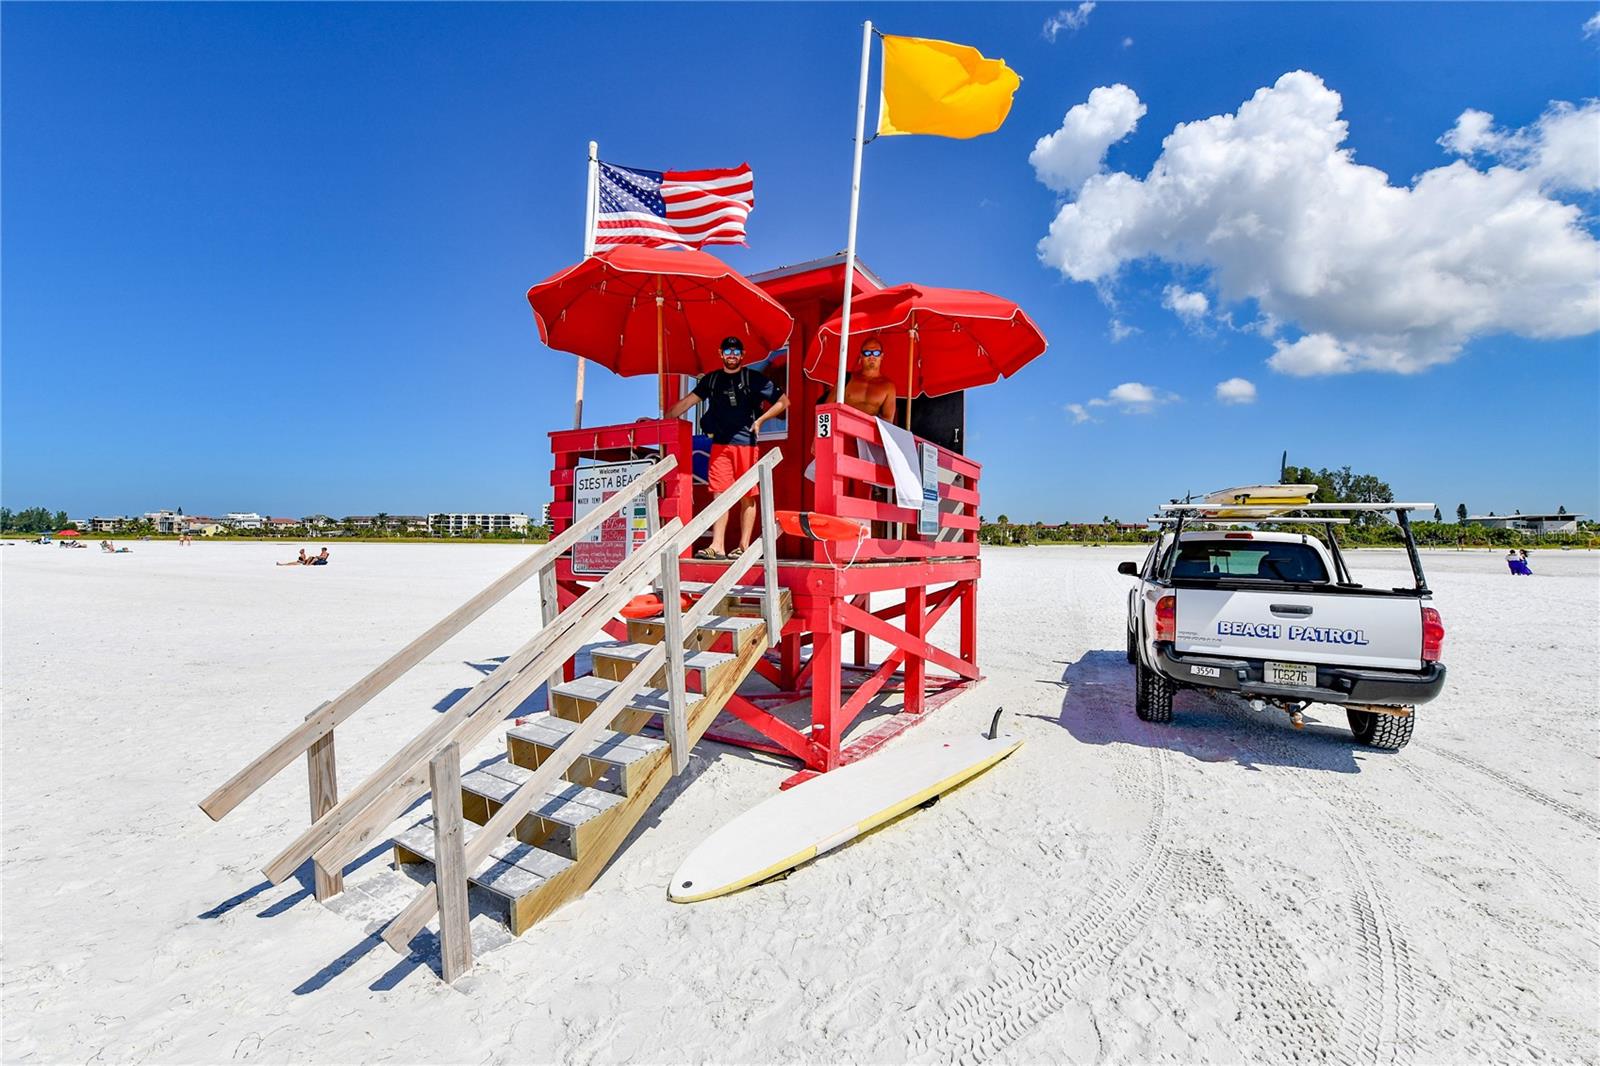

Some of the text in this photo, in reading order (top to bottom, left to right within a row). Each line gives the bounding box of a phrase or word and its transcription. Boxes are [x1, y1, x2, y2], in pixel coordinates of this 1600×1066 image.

[819, 415, 829, 424] SB
[820, 424, 828, 437] 3
[599, 467, 620, 475] Welcome
[579, 473, 642, 490] SIESTA BEAC
[1218, 621, 1369, 645] BEACH PATROL
